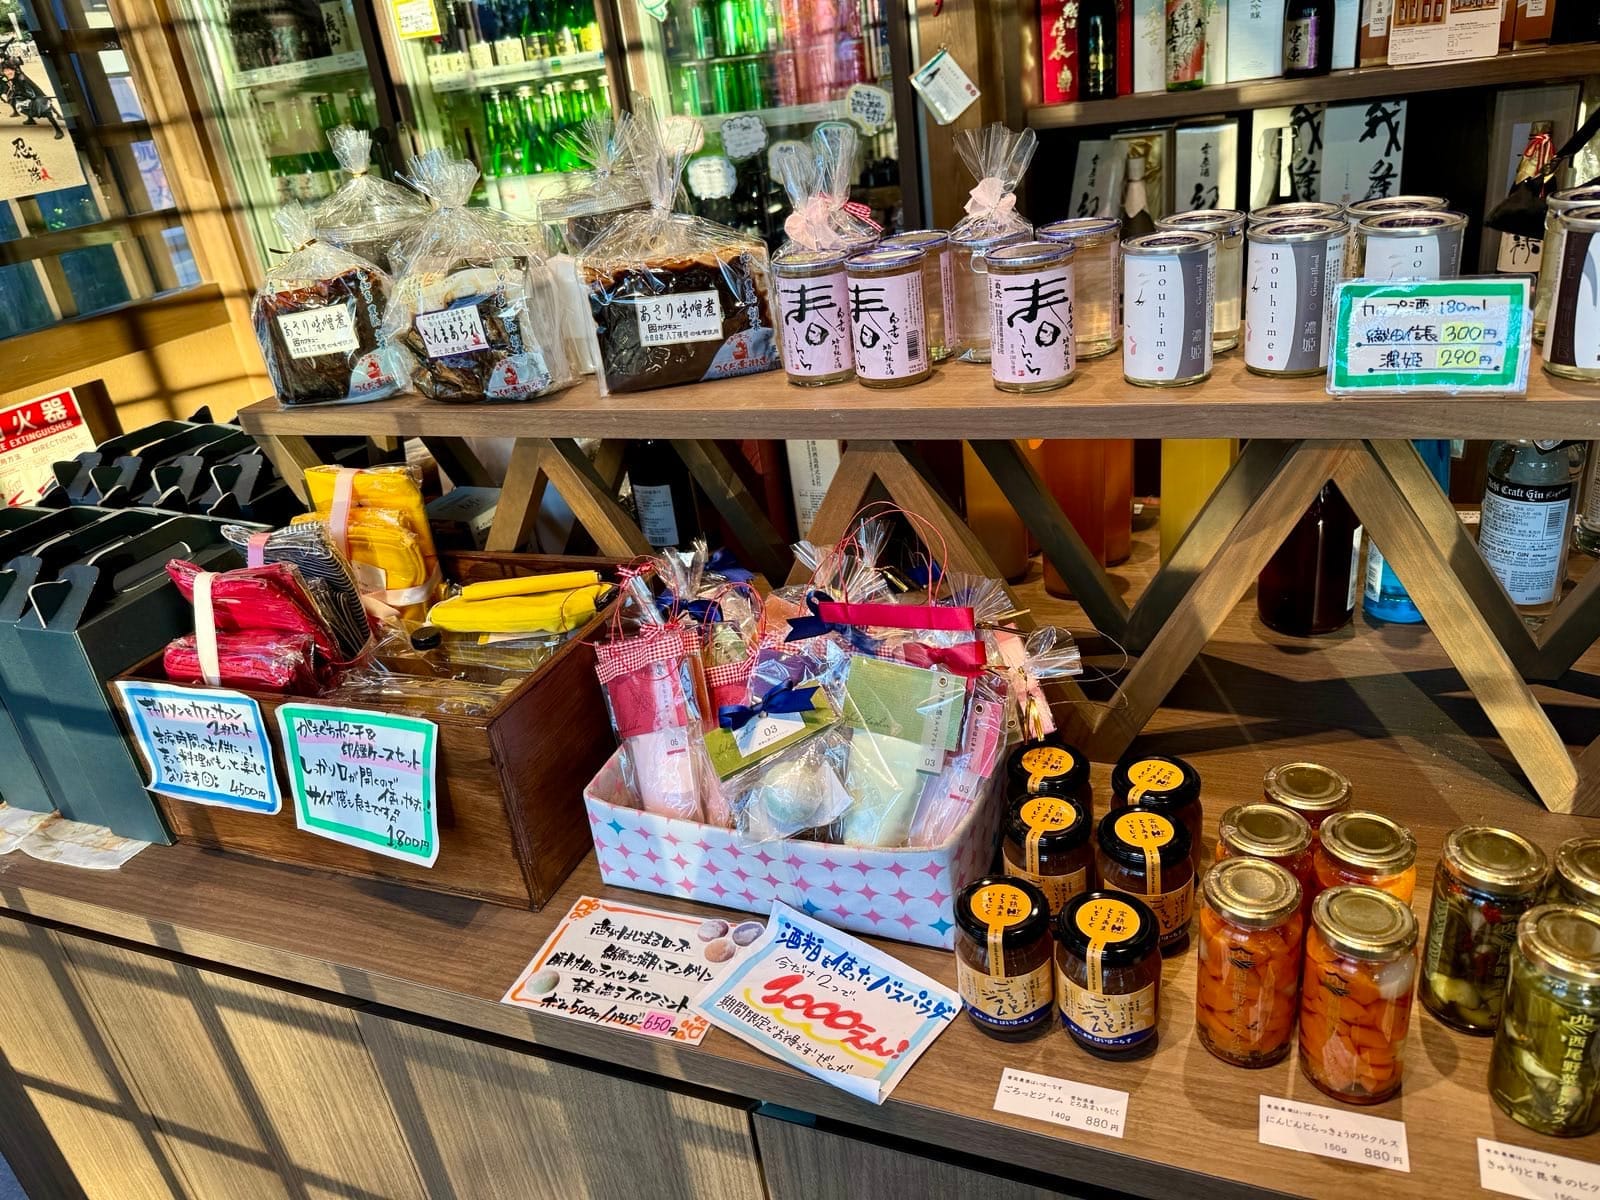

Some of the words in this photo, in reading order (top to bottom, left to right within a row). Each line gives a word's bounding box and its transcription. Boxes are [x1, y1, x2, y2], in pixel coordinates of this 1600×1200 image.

[640, 297, 717, 323] あさり味噌煮
[1156, 264, 1167, 360] nouhime
[1266, 252, 1279, 350] nouhime
[283, 311, 348, 338] あさり味噌煮
[423, 320, 481, 346] さんまあられ
[1444, 325, 1497, 342] 300円
[1439, 349, 1492, 367] 290円
[0, 396, 68, 441] 火器
[9, 420, 74, 448] EXTINGUISHER
[1500, 484, 1524, 498] Craft
[1525, 488, 1545, 502] Gin
[763, 723, 778, 737] 03
[341, 741, 421, 770] 印鑑ケースセット
[924, 757, 936, 768] 03
[299, 755, 399, 791] しっかり口が開くので
[387, 824, 430, 850] 1,800円
[590, 918, 692, 954] 恋がはじまるローズ
[546, 952, 650, 985] 晴れた日のラベンダー
[775, 922, 957, 1022] 酒粕を使ったバスパウダー
[993, 979, 1023, 1014] ごろっと
[1090, 997, 1119, 1034] ごろっと
[1003, 1085, 1064, 1105] ごろっとジャム
[1050, 1110, 1071, 1122] 140g
[1085, 1116, 1119, 1132] 880円
[1265, 1115, 1399, 1149] にんじんとらっきょうのピクルス
[1363, 1147, 1403, 1166] 880円
